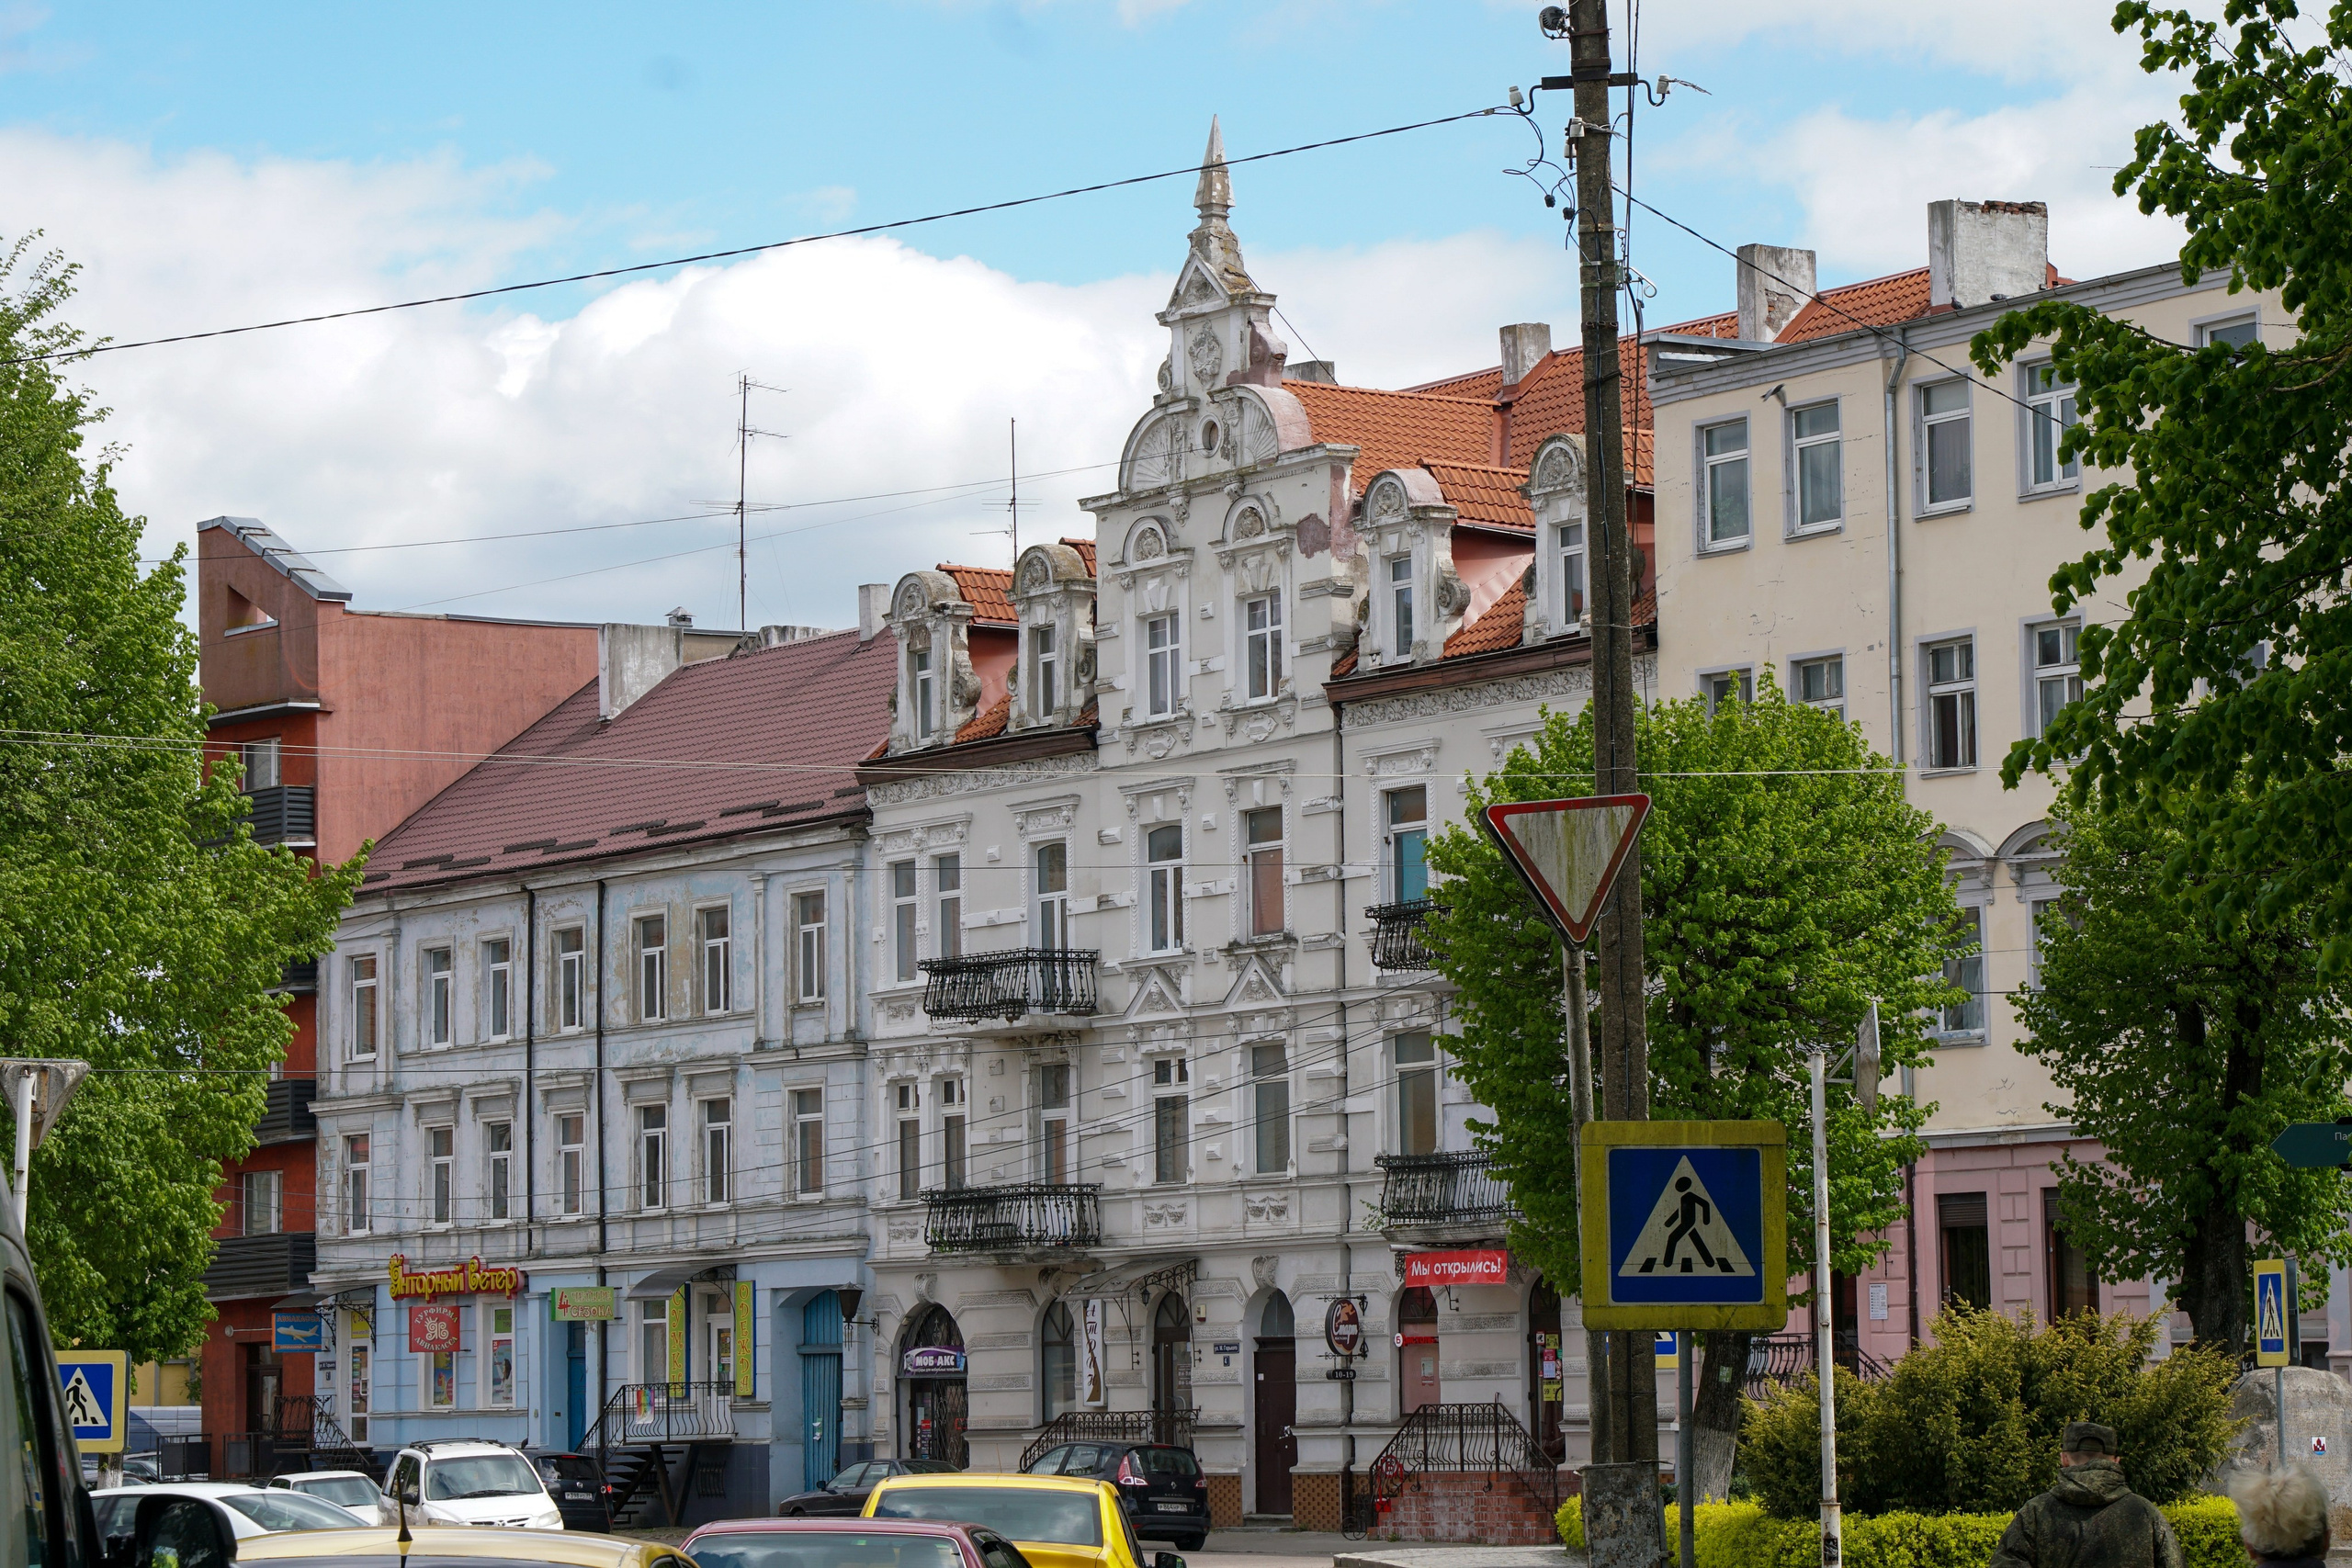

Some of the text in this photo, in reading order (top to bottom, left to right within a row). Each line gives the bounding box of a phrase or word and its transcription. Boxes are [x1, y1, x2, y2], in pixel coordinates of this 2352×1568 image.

[1411, 1257, 1501, 1278] Мы открылись!
[389, 1255, 517, 1301] Янтарный Ветер
[571, 1290, 612, 1303] ЧЕТЫРЕ
[414, 1306, 458, 1324] ТУРФИРМА
[571, 1304, 614, 1318] СЕЗОНА
[414, 1336, 458, 1351] АВИАКАССА
[672, 1287, 684, 1393] СУМКИ
[738, 1283, 752, 1392] ОДЕЖДА
[916, 1355, 955, 1367] МОБ АКС
